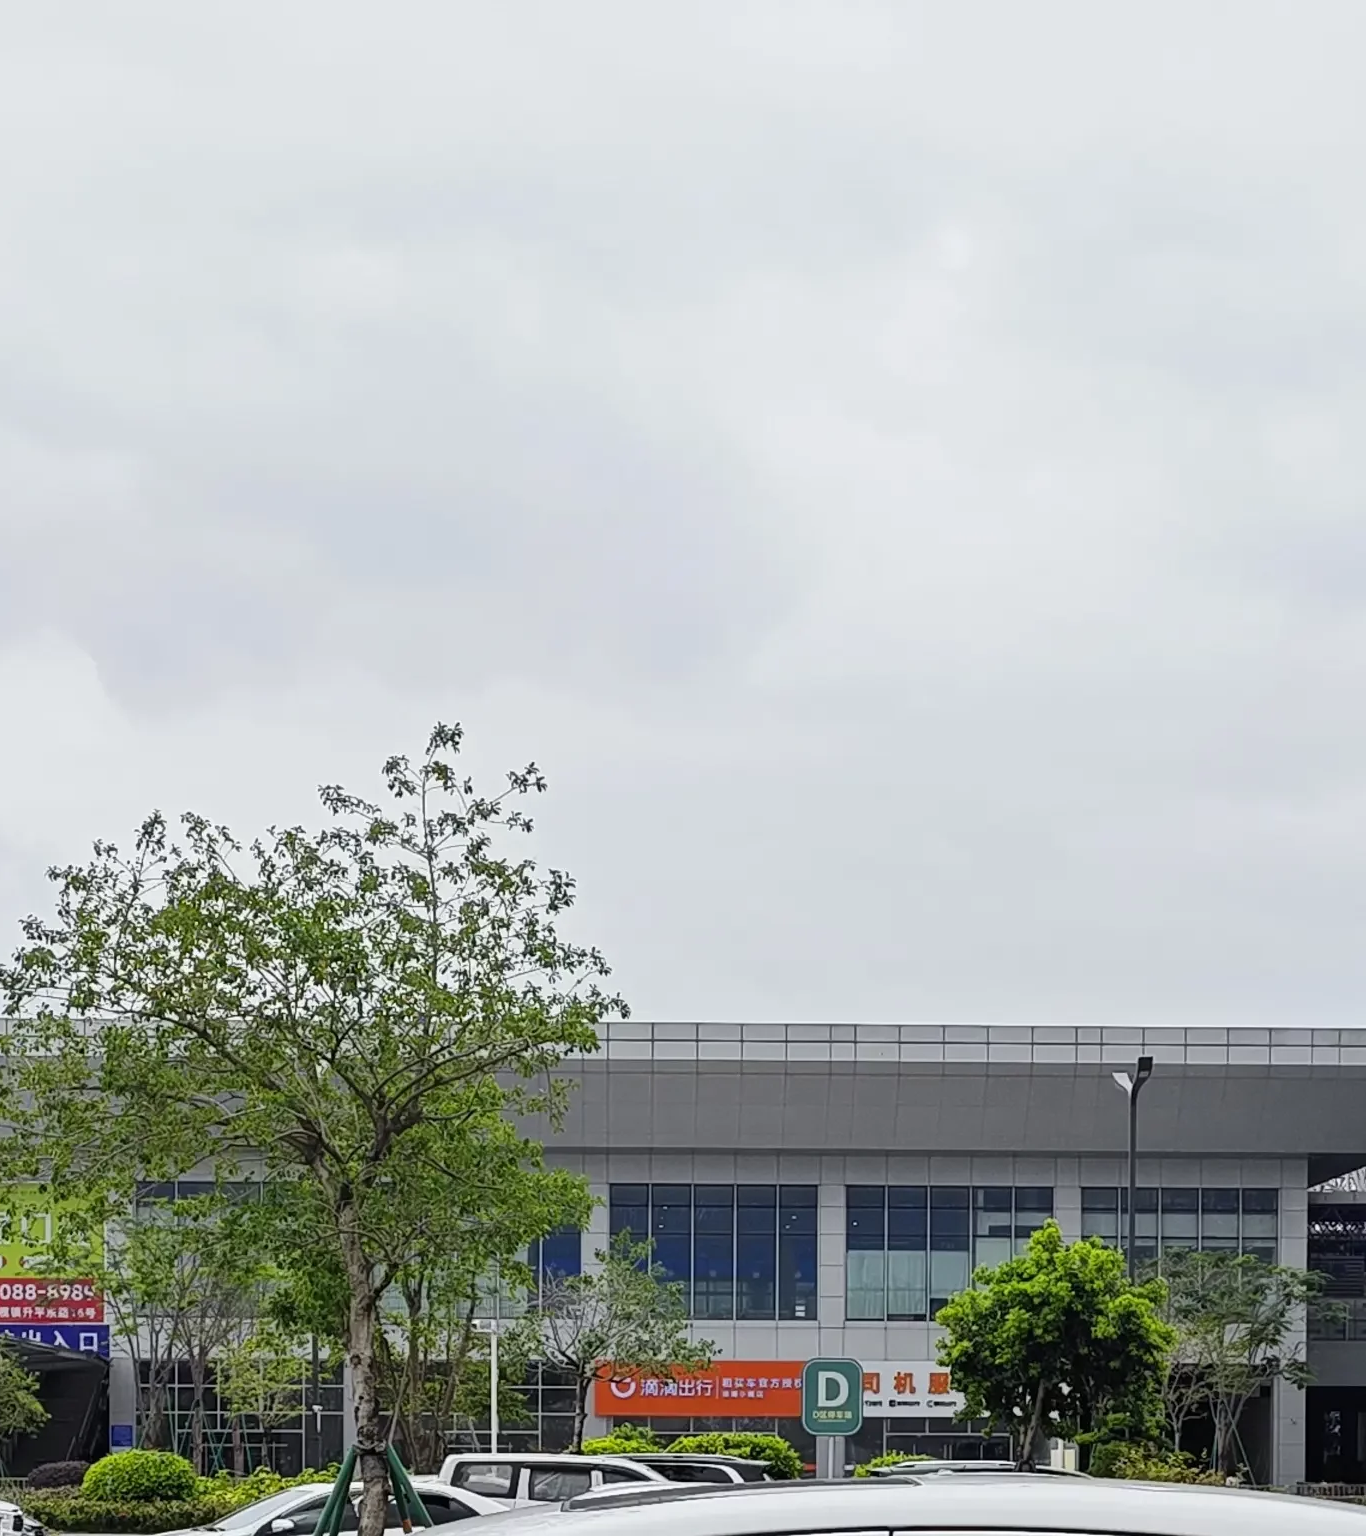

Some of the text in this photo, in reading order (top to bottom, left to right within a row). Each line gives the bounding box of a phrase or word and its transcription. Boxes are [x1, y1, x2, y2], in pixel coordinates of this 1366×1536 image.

[640, 1378, 713, 1397] 滴滴出行
[817, 1371, 849, 1407] D
